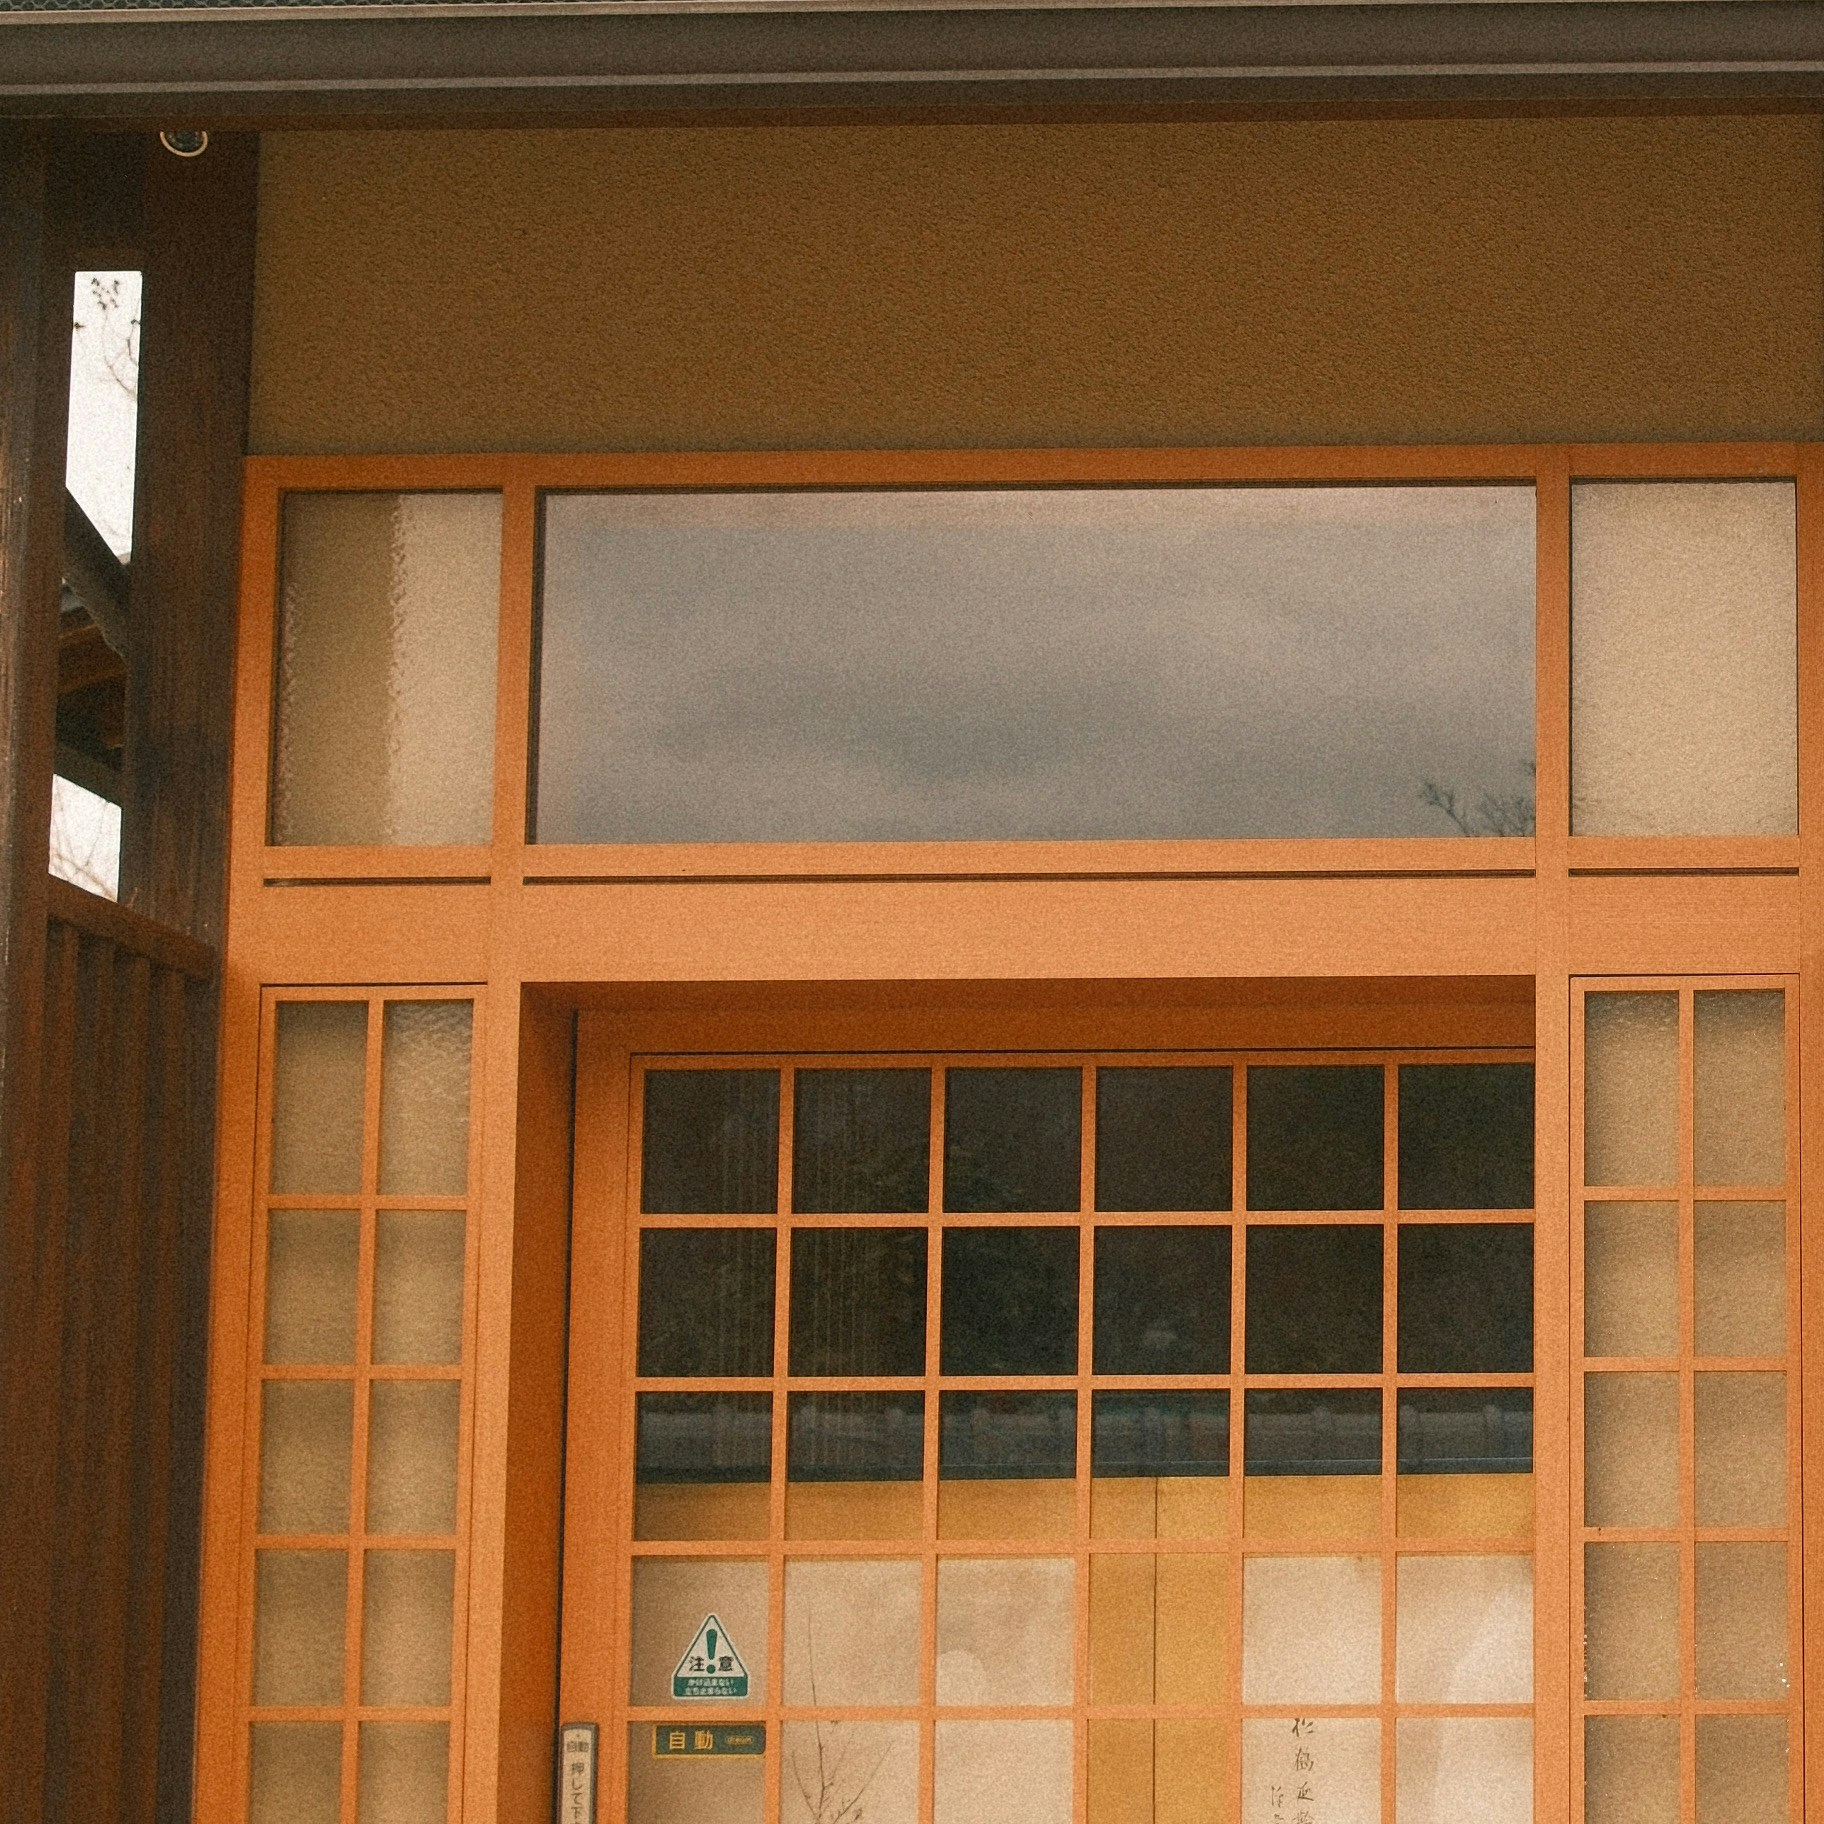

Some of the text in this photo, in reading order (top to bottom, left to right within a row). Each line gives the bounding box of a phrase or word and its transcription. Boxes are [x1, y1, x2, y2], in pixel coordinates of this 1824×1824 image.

[688, 1655, 734, 1672] 注意
[566, 1740, 589, 1753] 自動
[669, 1730, 714, 1751] 自動
